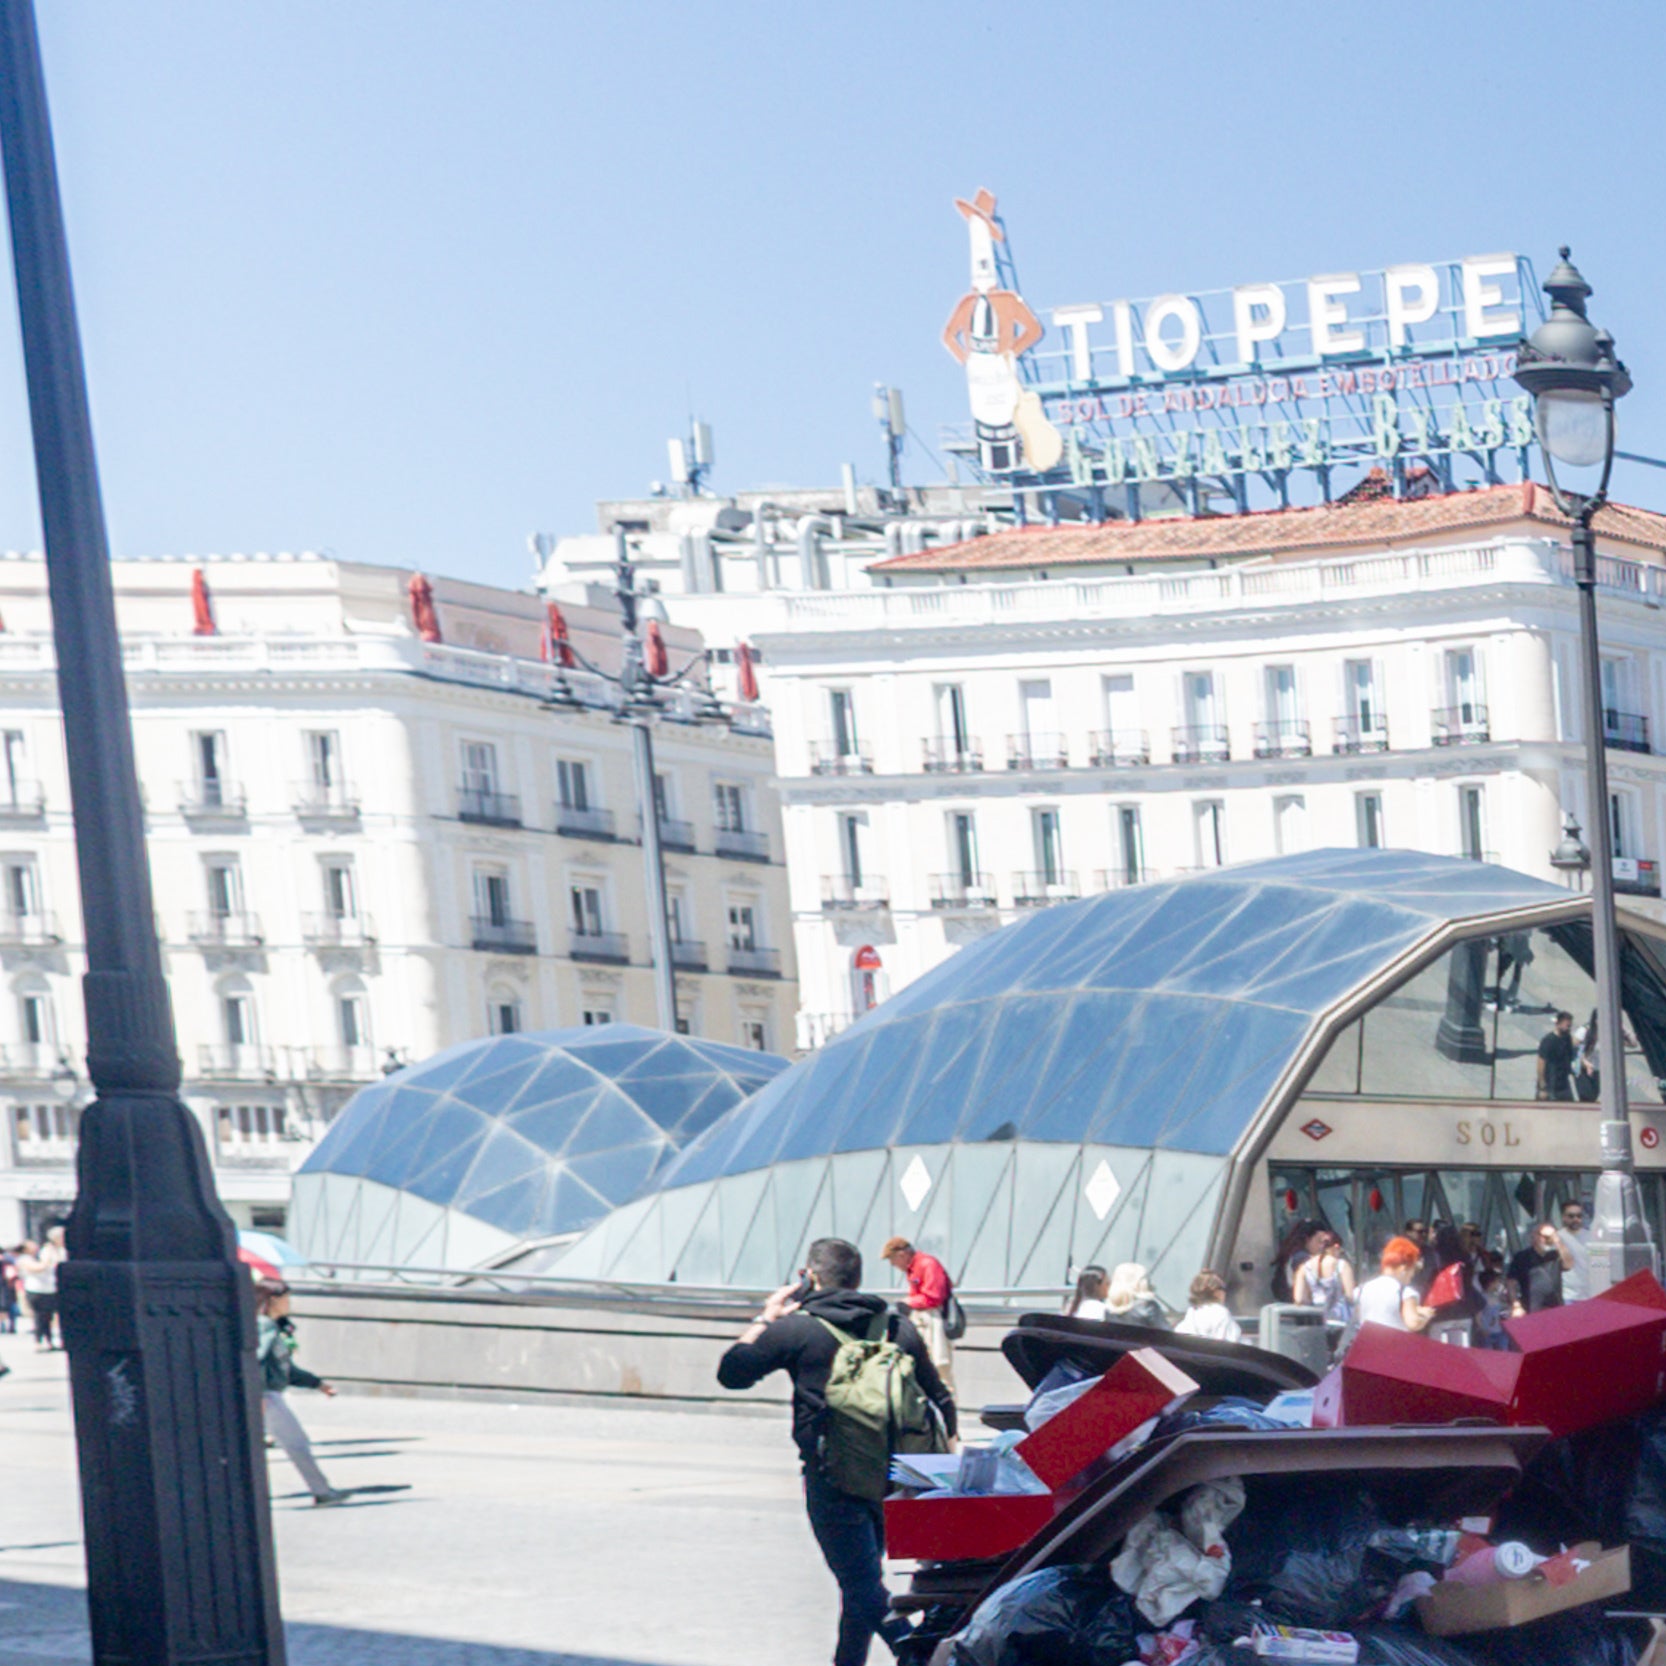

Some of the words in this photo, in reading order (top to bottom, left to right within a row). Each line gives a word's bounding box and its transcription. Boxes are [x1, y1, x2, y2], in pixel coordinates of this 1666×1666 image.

[1054, 293, 1201, 381] TIO
[1232, 252, 1521, 363] PEPE
[1456, 1121, 1521, 1147] SOL
